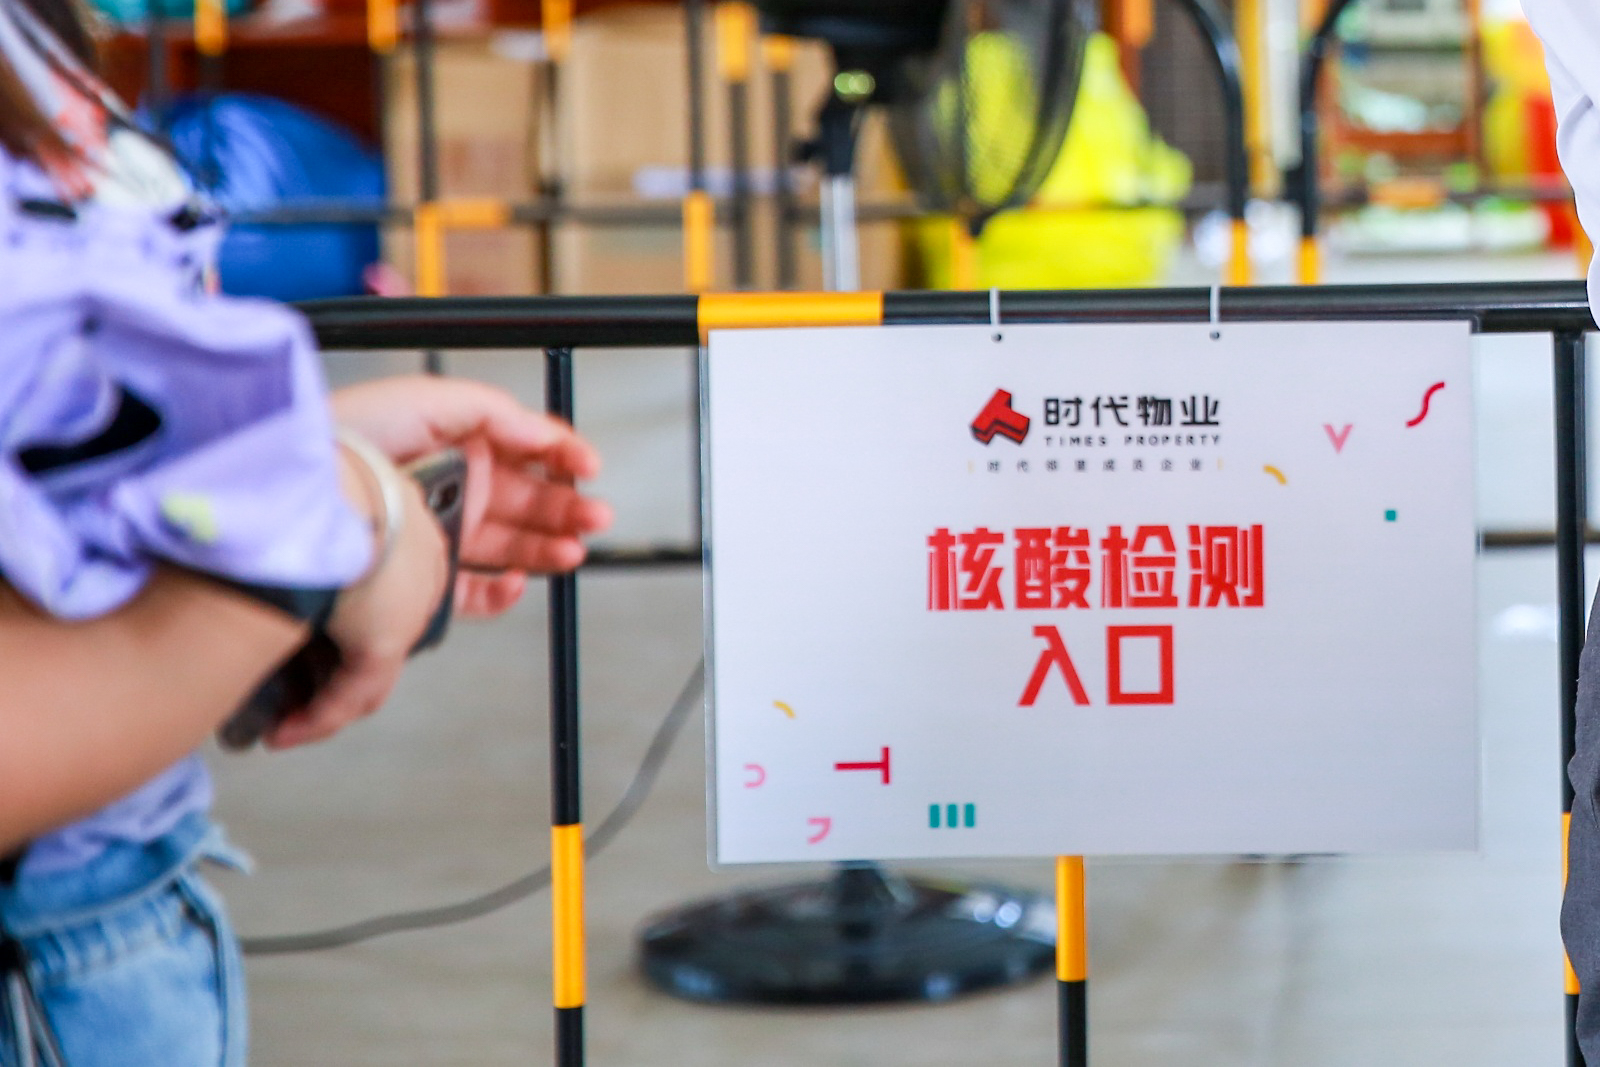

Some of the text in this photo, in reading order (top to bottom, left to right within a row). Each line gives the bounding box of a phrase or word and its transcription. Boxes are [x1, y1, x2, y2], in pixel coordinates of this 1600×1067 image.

[1043, 395, 1220, 427] 时代物业
[1043, 435, 1220, 446] TIMES PROPERTY
[926, 523, 1266, 611] 核酸检测
[1018, 624, 1175, 707] 入口
